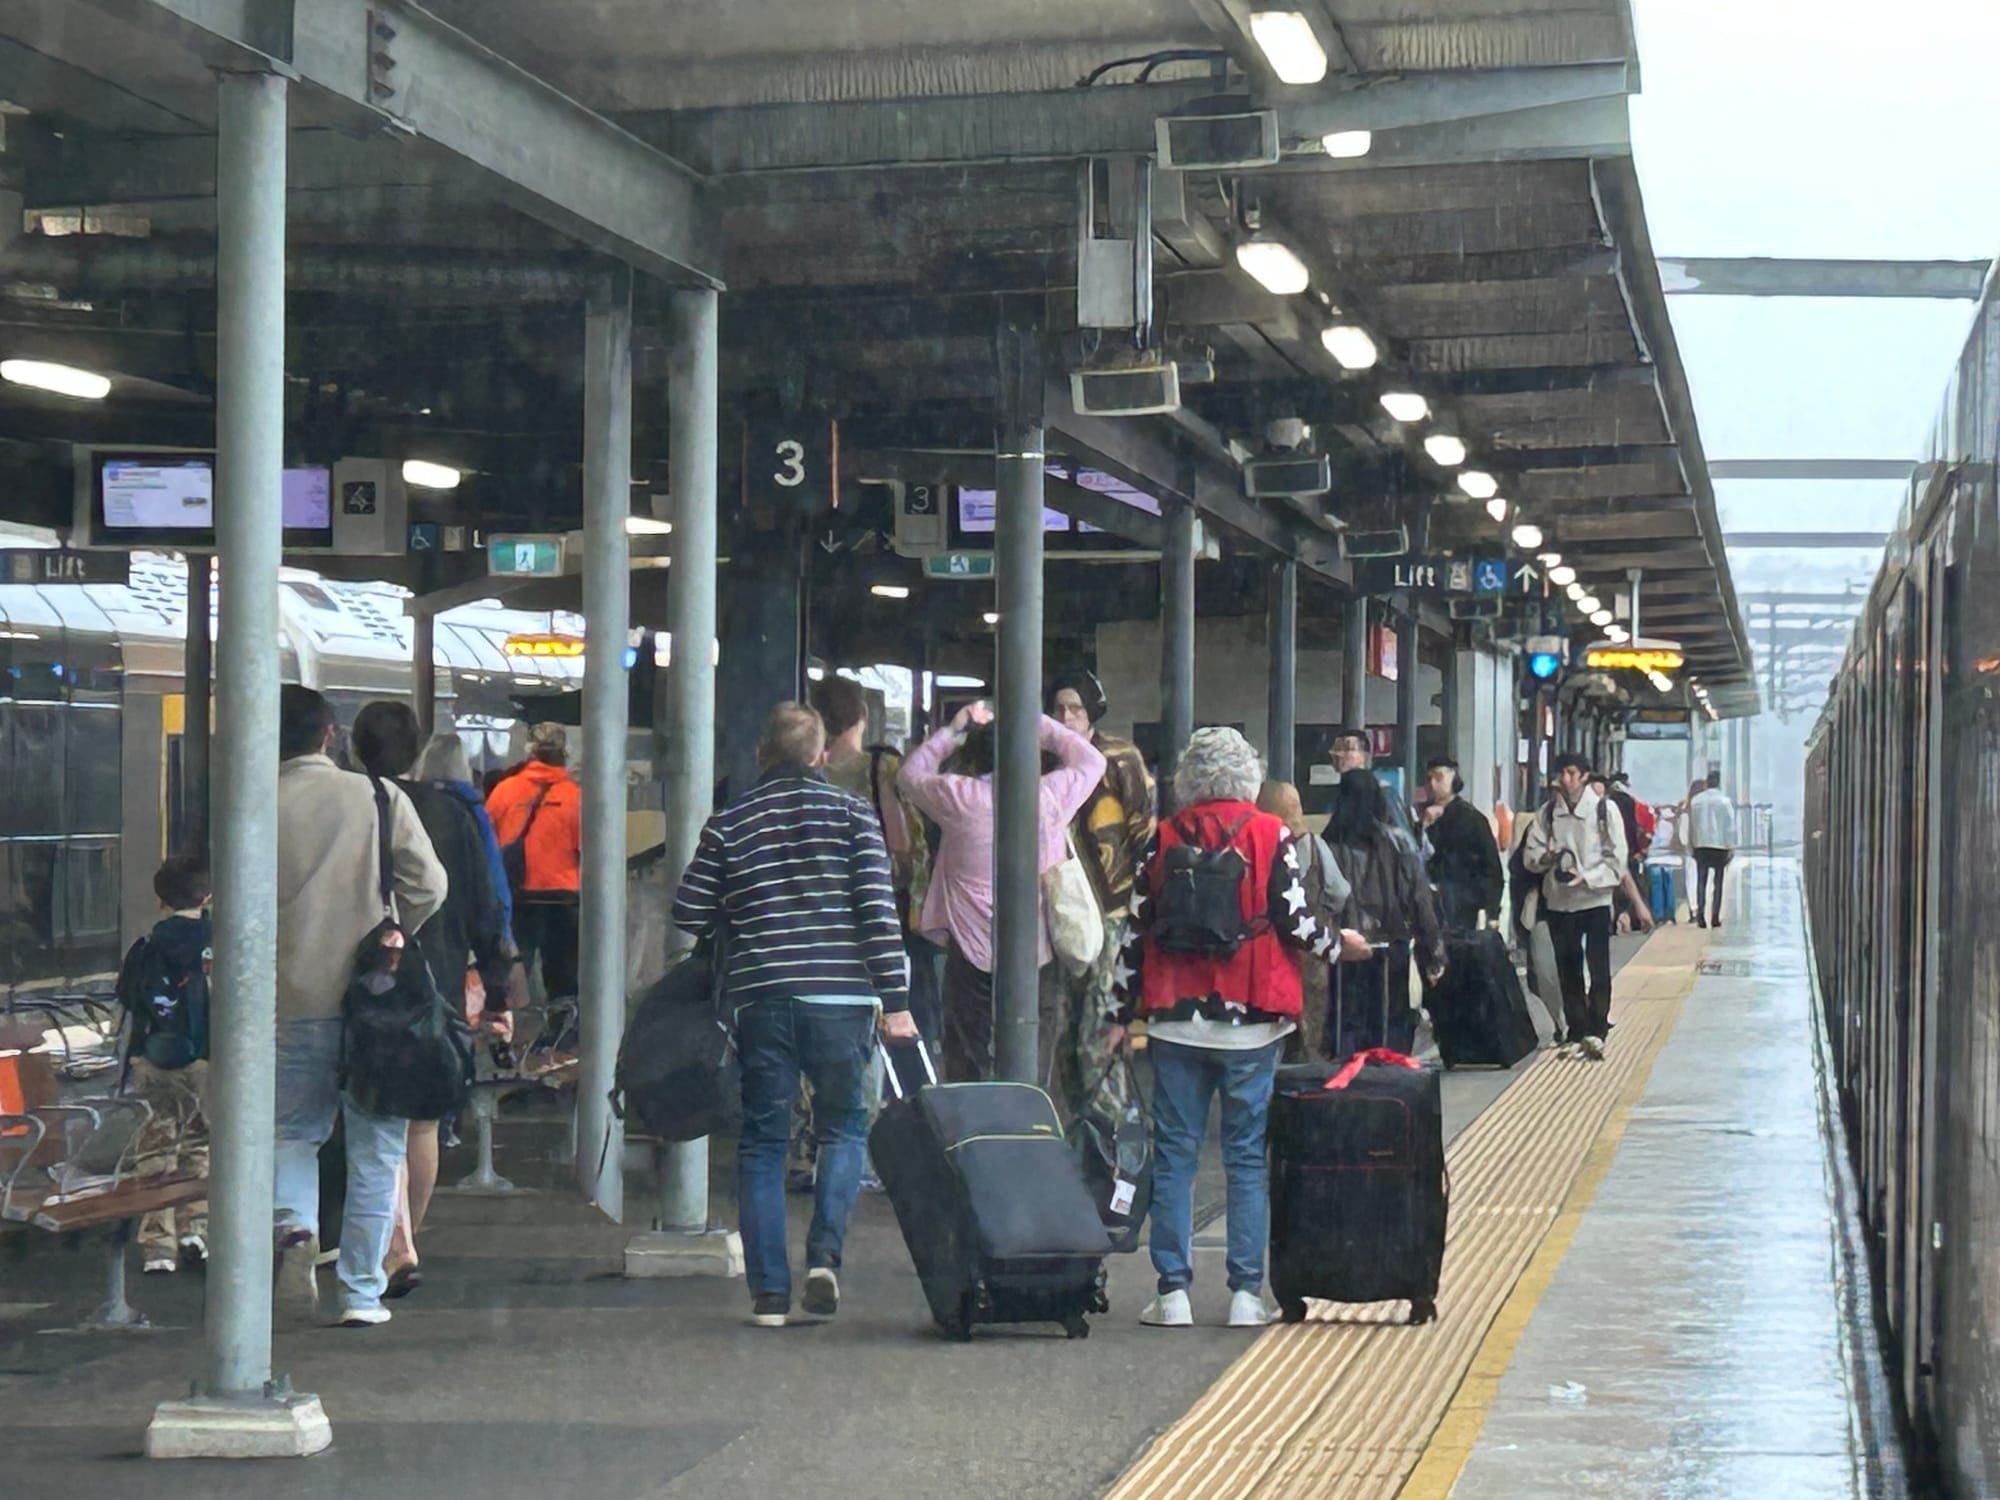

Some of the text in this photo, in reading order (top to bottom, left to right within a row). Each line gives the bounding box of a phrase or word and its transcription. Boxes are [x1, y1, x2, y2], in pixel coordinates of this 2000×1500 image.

[774, 439, 805, 487] 3
[911, 486, 929, 511] 3
[1394, 564, 1435, 587] Lift
